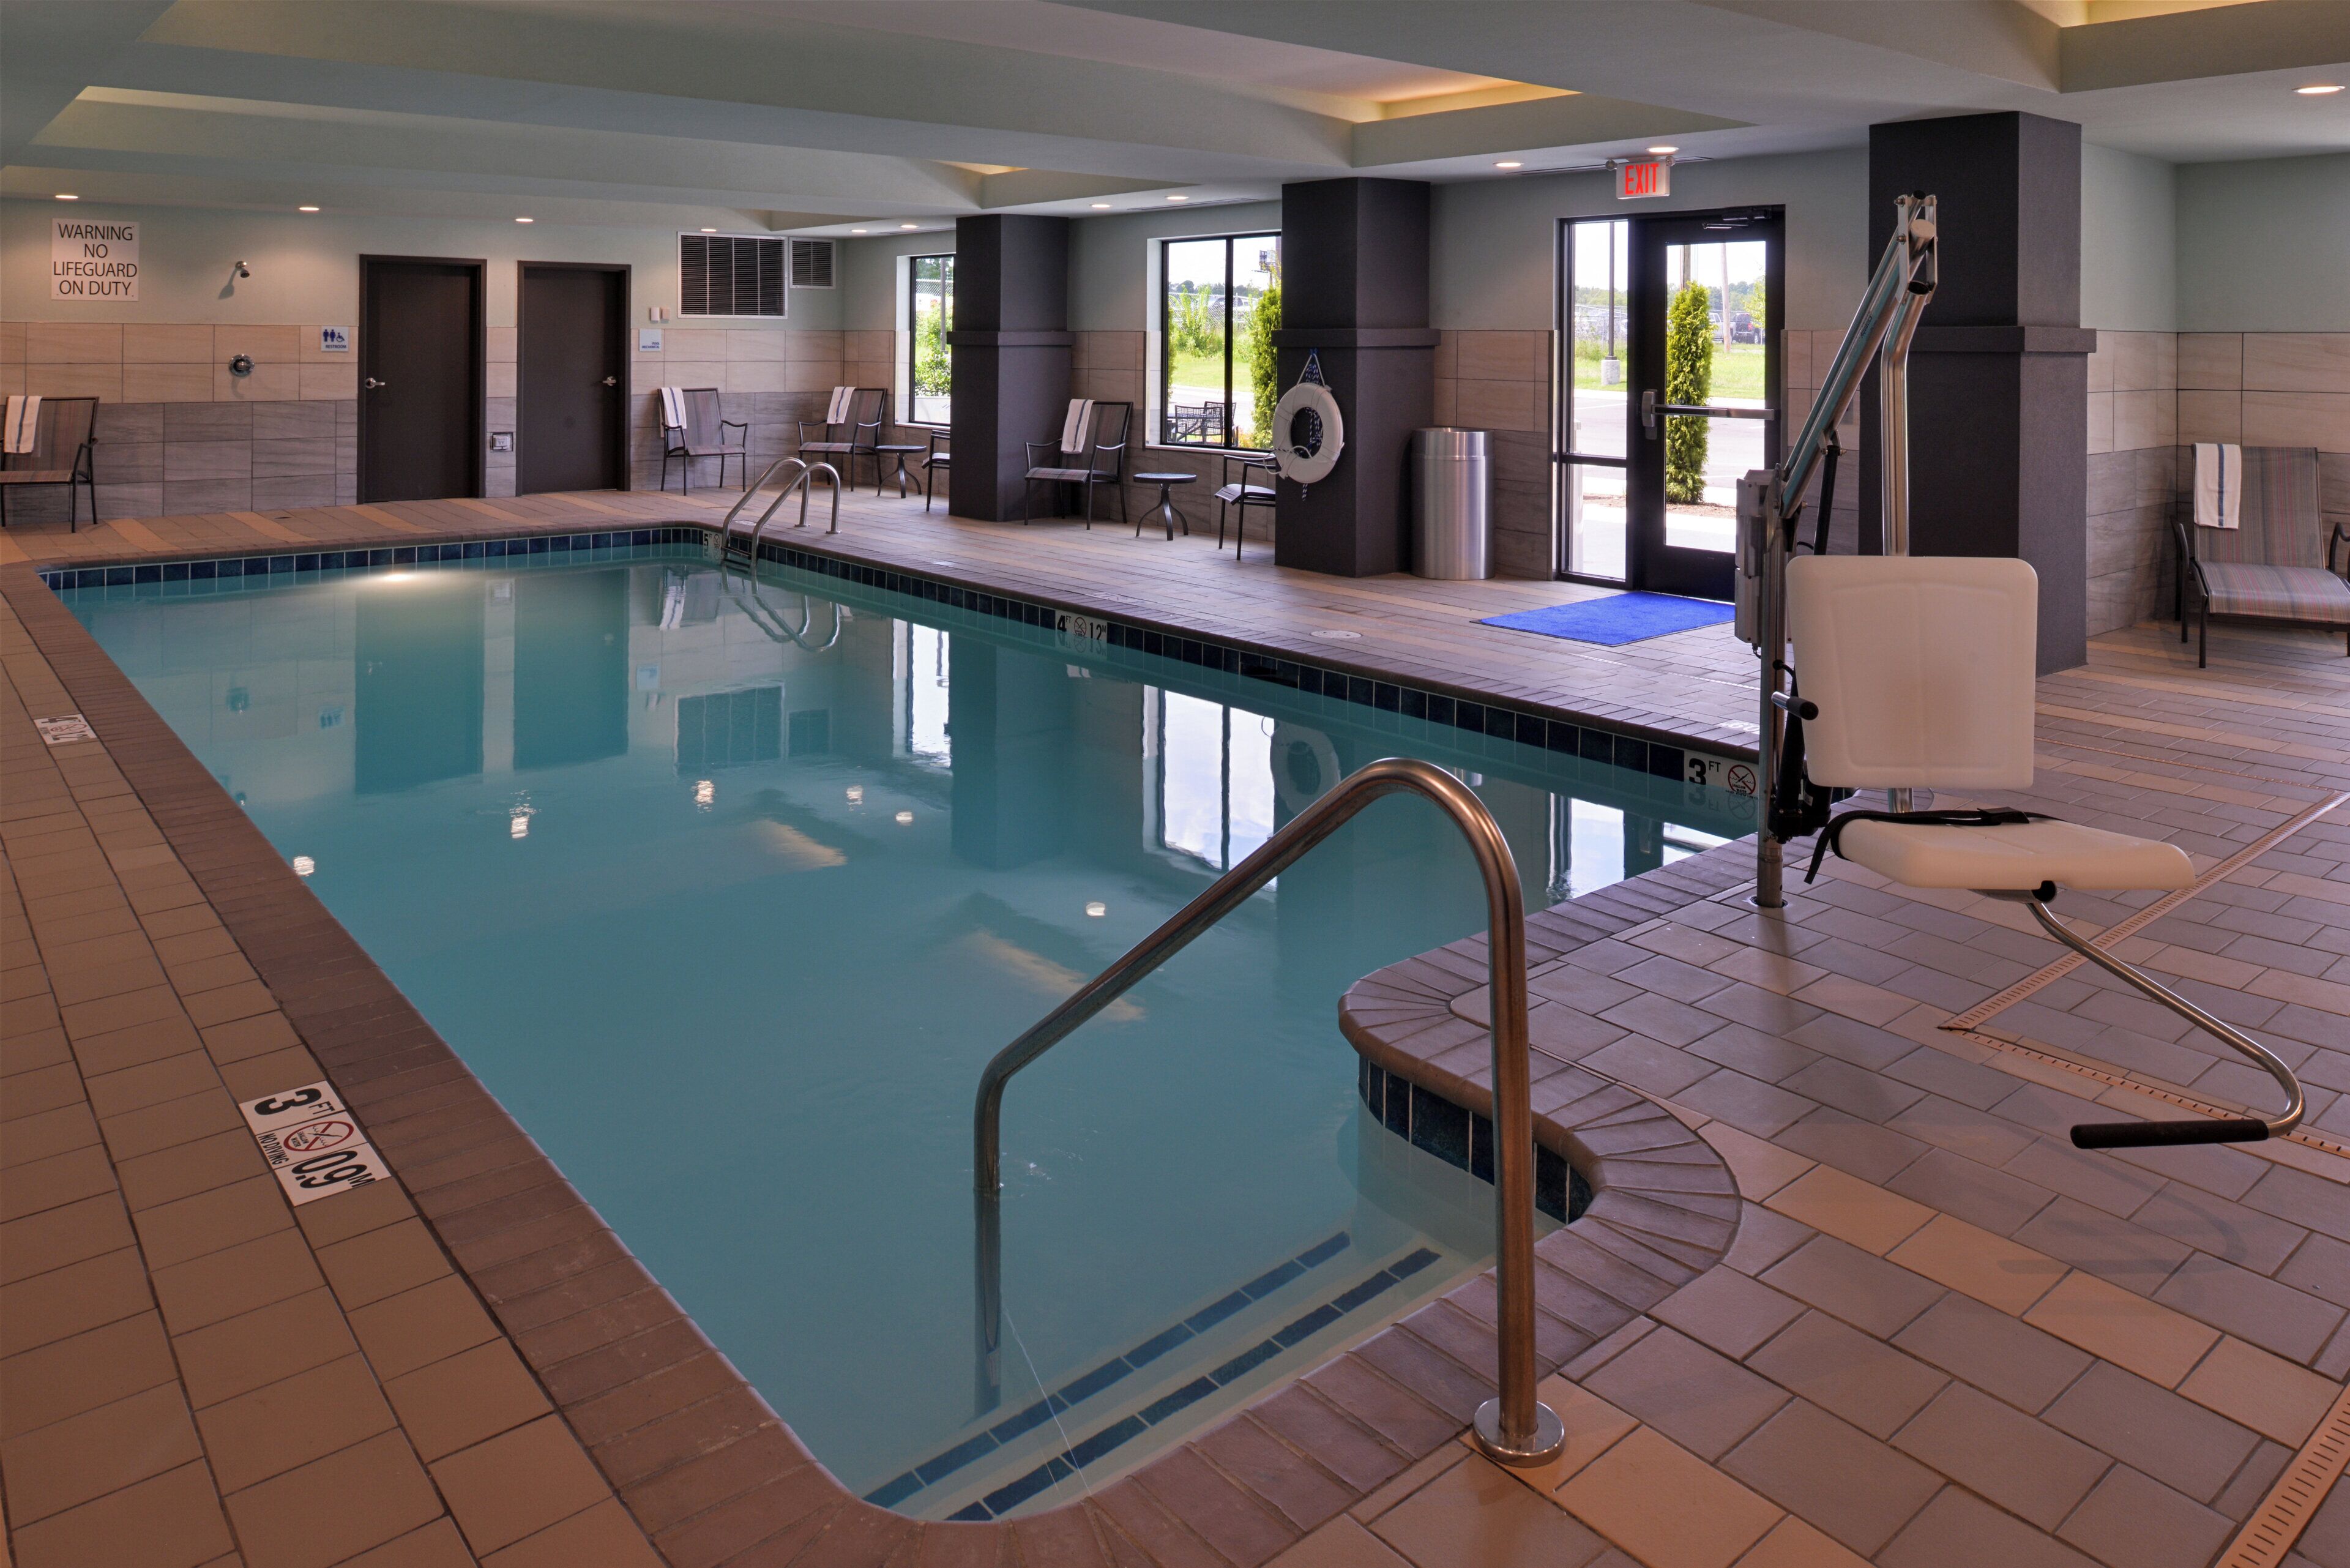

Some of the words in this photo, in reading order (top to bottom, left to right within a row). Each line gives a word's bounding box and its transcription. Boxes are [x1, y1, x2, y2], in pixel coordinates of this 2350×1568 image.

[1625, 163, 1659, 195] EXIT
[58, 223, 133, 241] WARNING
[84, 244, 108, 258] NO
[53, 261, 138, 277] LIFEGUARD
[59, 280, 83, 295] ON
[89, 281, 132, 296] DUTY
[1057, 615, 1067, 632] 4
[1102, 625, 1106, 633] M
[1689, 758, 1706, 785] 3
[1709, 760, 1721, 772] FT
[254, 1088, 322, 1115] 3
[308, 1101, 335, 1115] FT
[258, 1132, 276, 1144] NO
[291, 1137, 301, 1148] WATER
[297, 1130, 310, 1144] SHALLOW
[263, 1141, 290, 1165] DIVING
[291, 1150, 367, 1189] 0.9
[347, 1172, 376, 1188] M
